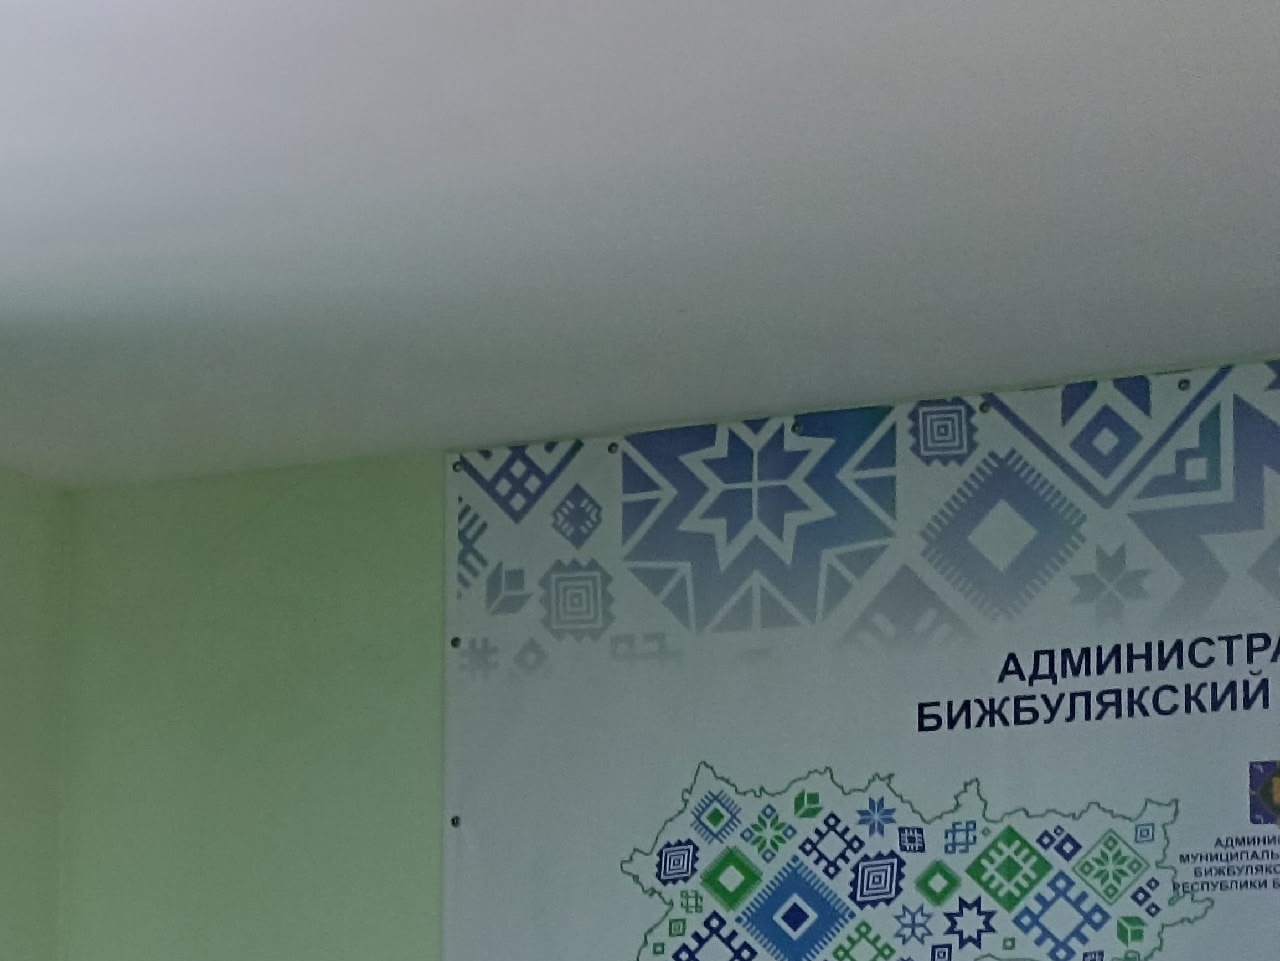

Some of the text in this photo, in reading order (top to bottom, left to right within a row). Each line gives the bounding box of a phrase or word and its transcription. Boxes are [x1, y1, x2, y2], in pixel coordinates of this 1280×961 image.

[917, 669, 1269, 731] БИЖБУЛЯКСКИЙ
[1214, 835, 1280, 849] АДМИНИ
[1179, 849, 1280, 864] МУНИЦИПАЛЬ
[1173, 878, 1268, 893] РЕСПУБЛИКИ
